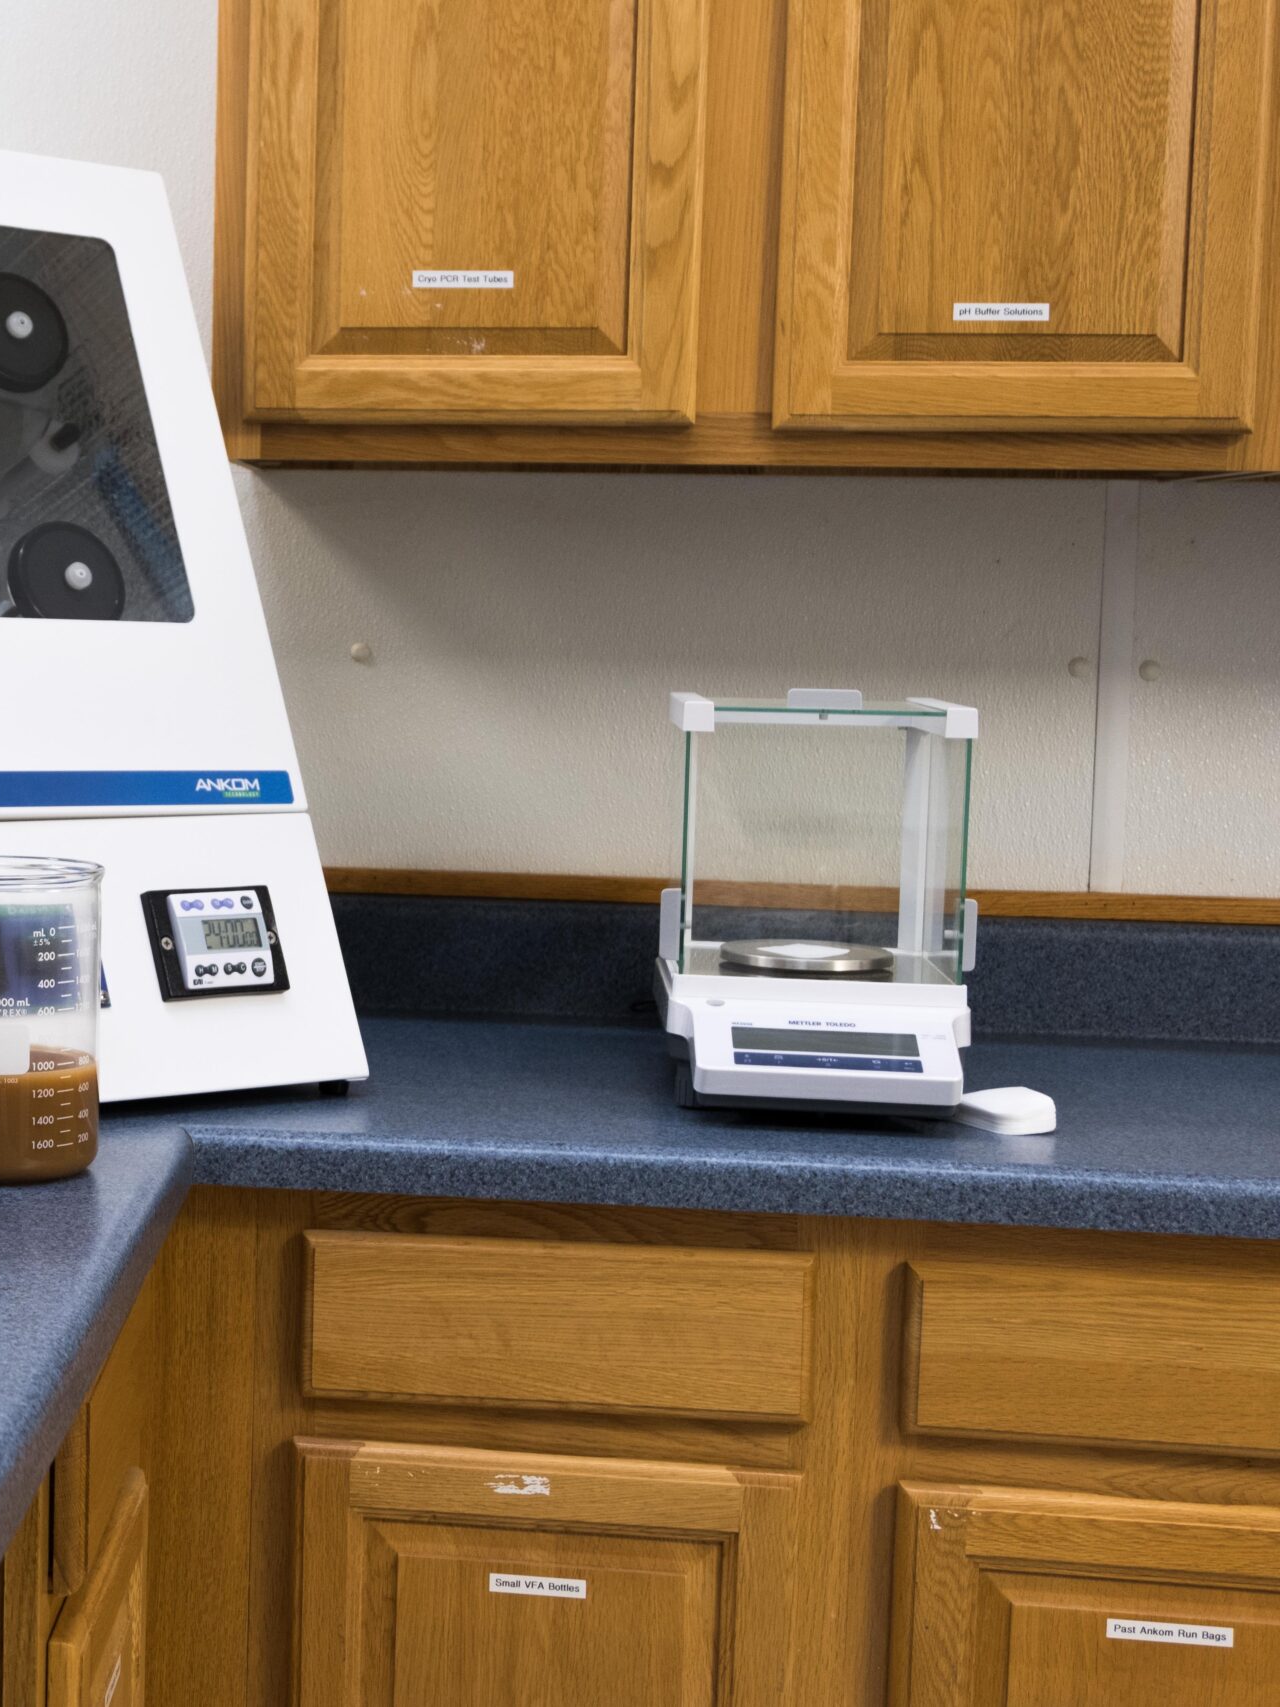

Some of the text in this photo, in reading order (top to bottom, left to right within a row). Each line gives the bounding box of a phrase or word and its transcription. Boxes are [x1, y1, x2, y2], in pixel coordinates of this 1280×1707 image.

[417, 274, 508, 283] Cryo PCR Test Tubes
[959, 307, 1043, 317] pH Buffer Solutions
[195, 778, 260, 791] ANKOM
[33, 927, 56, 938] mL 0
[37, 951, 56, 962] 200
[37, 979, 56, 989] 400
[16, 997, 31, 1007] mL
[37, 1006, 55, 1016] 600
[78, 1055, 90, 1065] 800
[32, 1060, 55, 1072] 1000
[77, 1082, 90, 1093] 600
[32, 1088, 55, 1099] 1200
[77, 1109, 89, 1119] 400
[32, 1115, 55, 1126] 1400
[77, 1132, 89, 1143] 200
[31, 1139, 54, 1150] 1600
[495, 1578, 580, 1593] Small VFA Bottles
[1113, 1623, 1227, 1642] Past Ankom Run Bags
